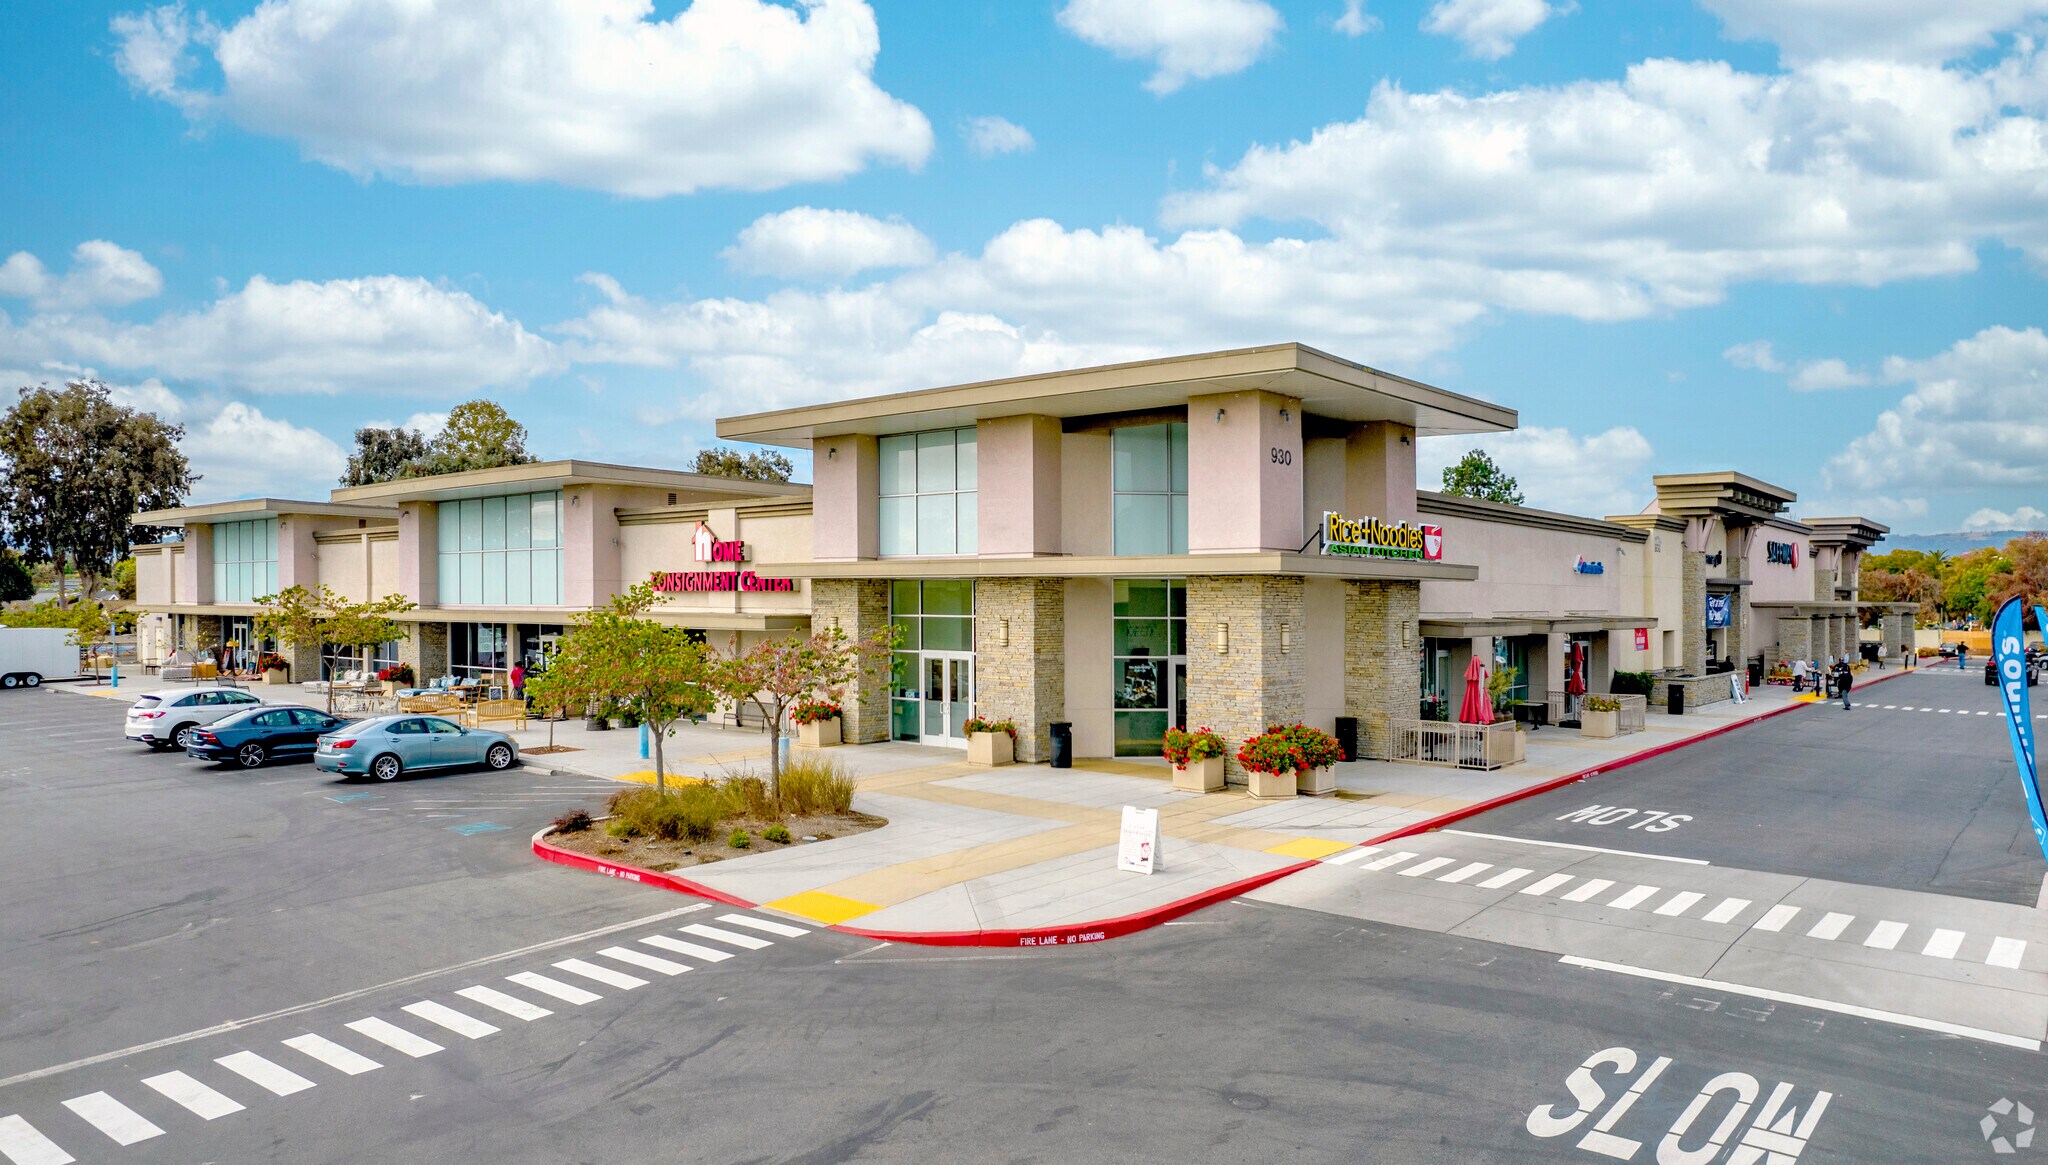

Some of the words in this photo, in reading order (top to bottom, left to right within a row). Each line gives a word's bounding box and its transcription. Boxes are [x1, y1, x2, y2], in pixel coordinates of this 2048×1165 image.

[1271, 447, 1292, 466] 930
[1329, 513, 1423, 549] Rice+Noodles
[1330, 543, 1369, 555] ASIAN
[1373, 547, 1423, 559] KITCHEN
[651, 571, 739, 592] CONSIGNMENT
[740, 571, 792, 592] CENTER
[1556, 804, 1694, 833] SLOW
[1020, 937, 1037, 946] FIRE
[1039, 936, 1058, 945] LANE
[1067, 935, 1077, 944] NO
[1078, 931, 1105, 942] PARKING
[1526, 1047, 1833, 1165] SLOW
